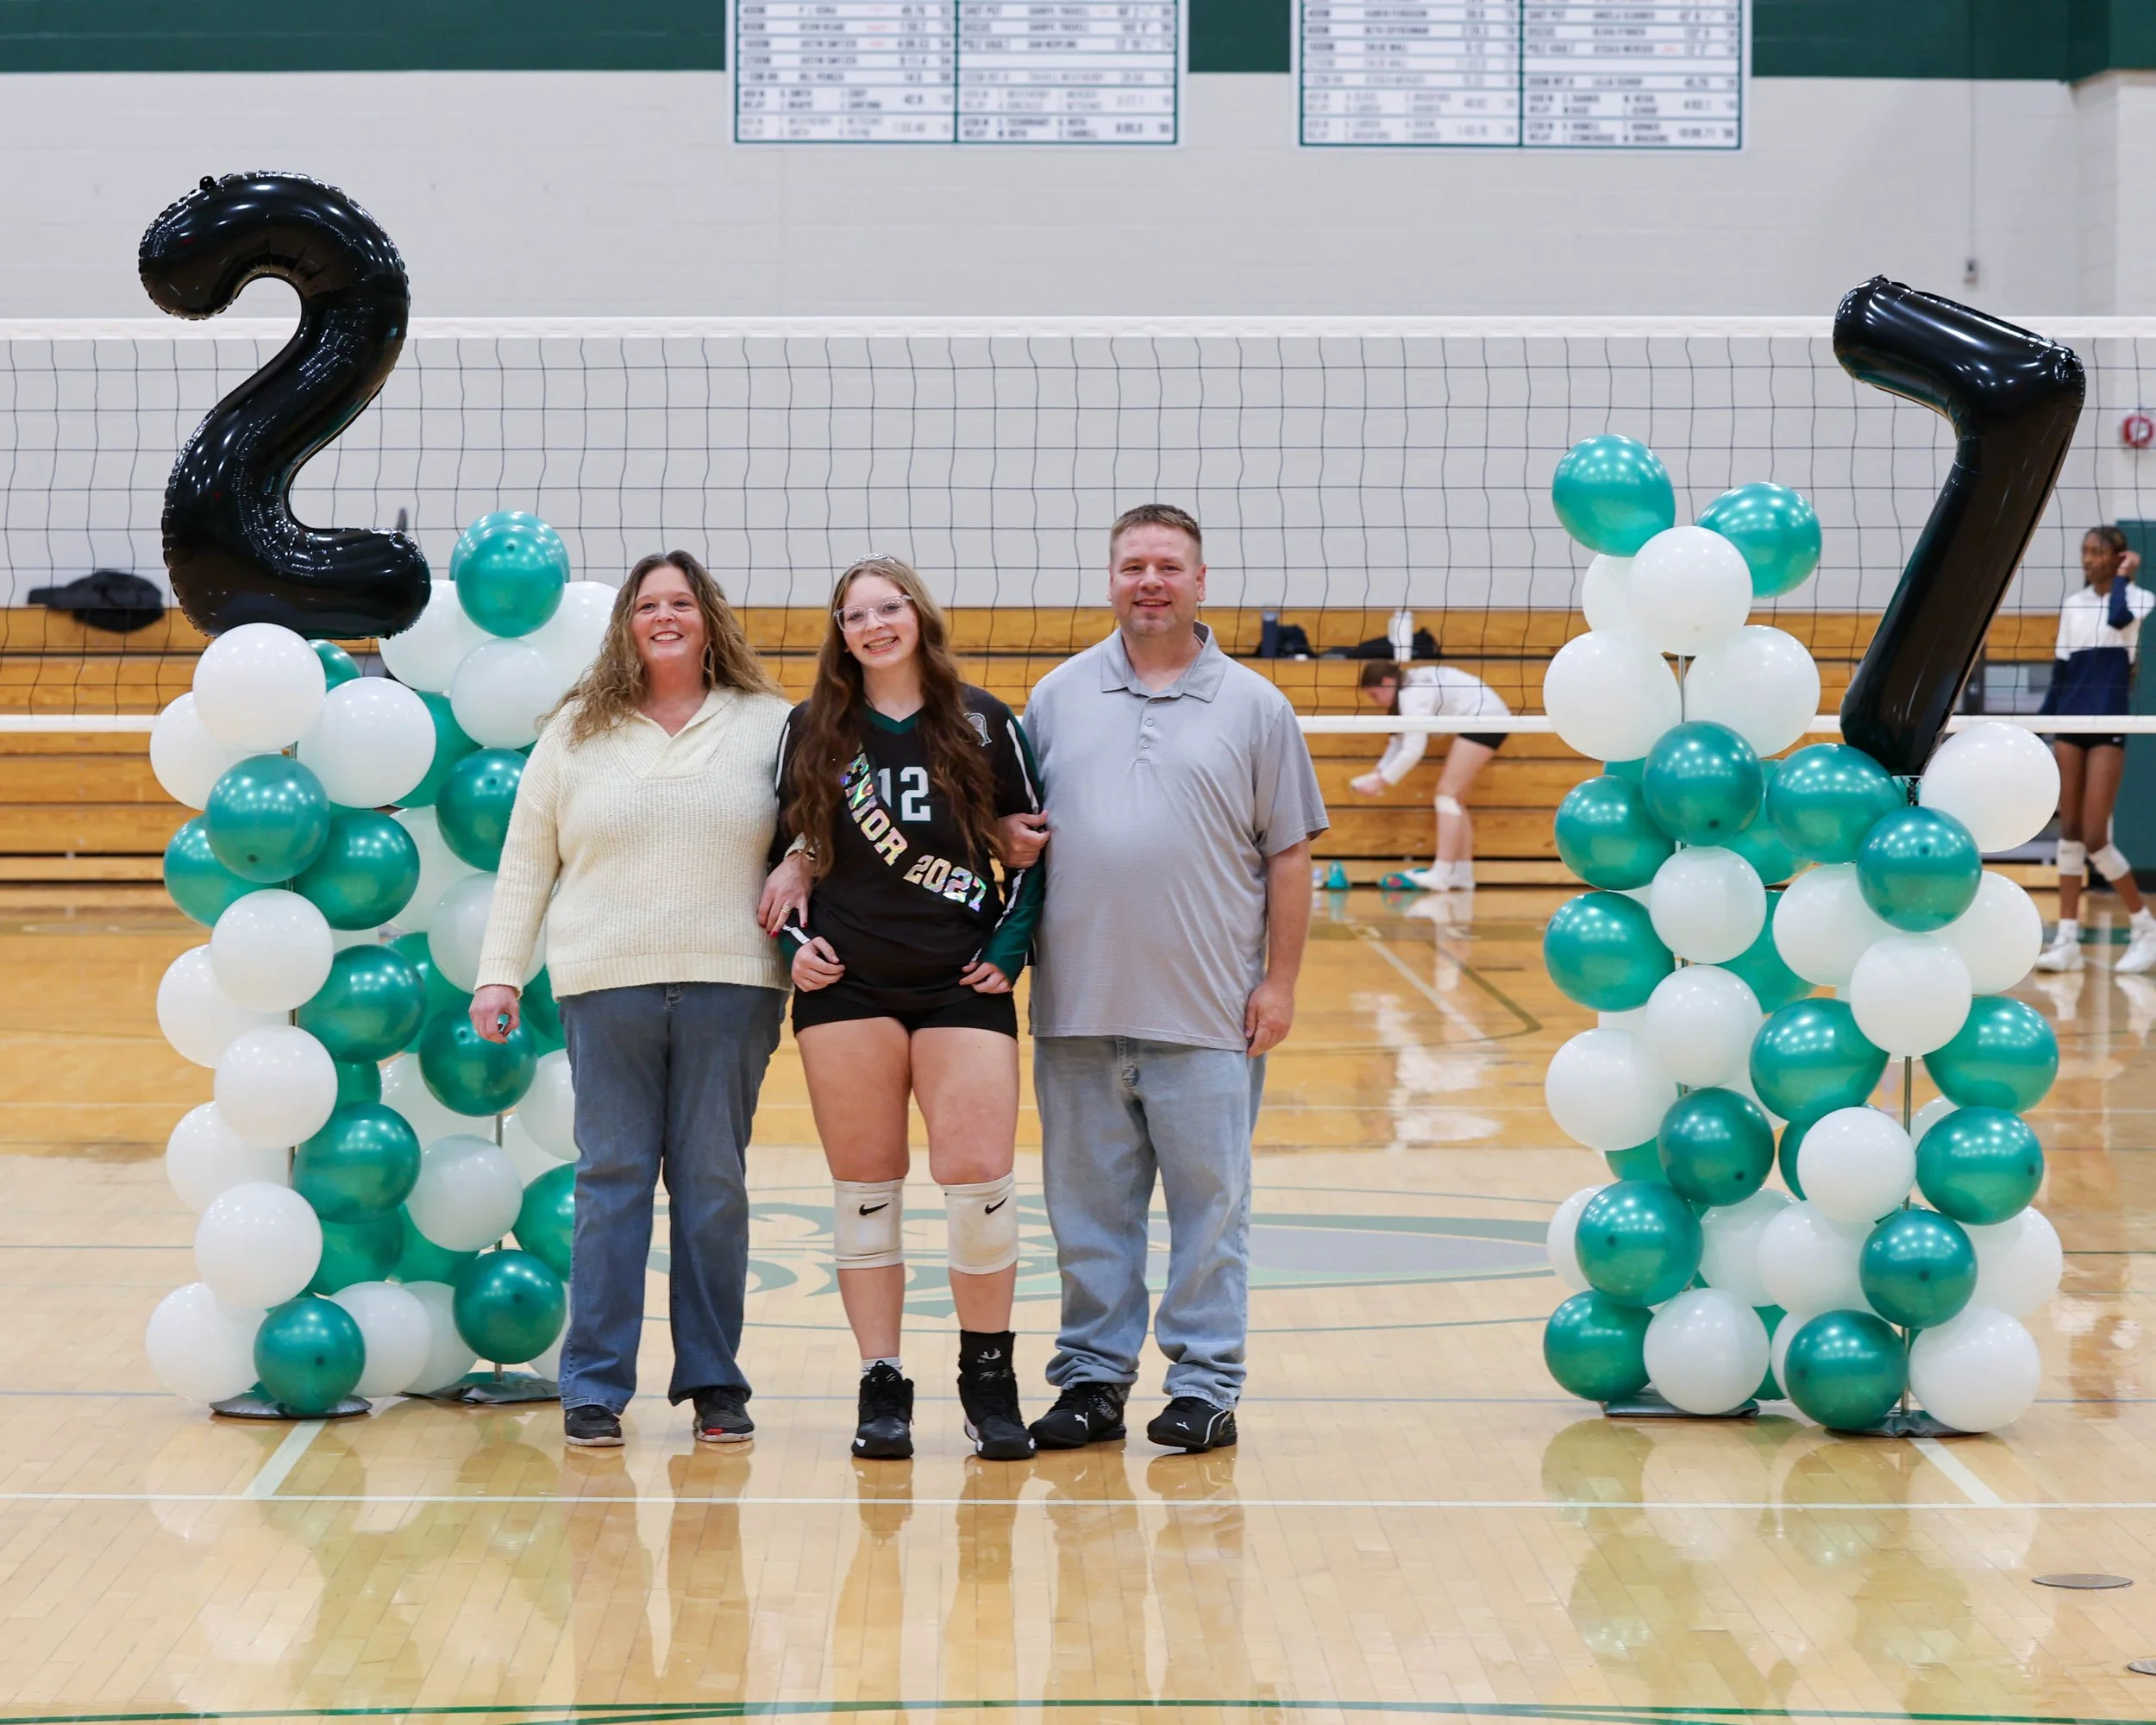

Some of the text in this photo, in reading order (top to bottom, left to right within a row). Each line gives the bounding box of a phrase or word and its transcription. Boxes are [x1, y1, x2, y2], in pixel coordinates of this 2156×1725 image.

[139, 171, 432, 640] 2
[1833, 274, 2086, 777] 7
[876, 765, 932, 822] 12
[902, 854, 988, 913] 2027
